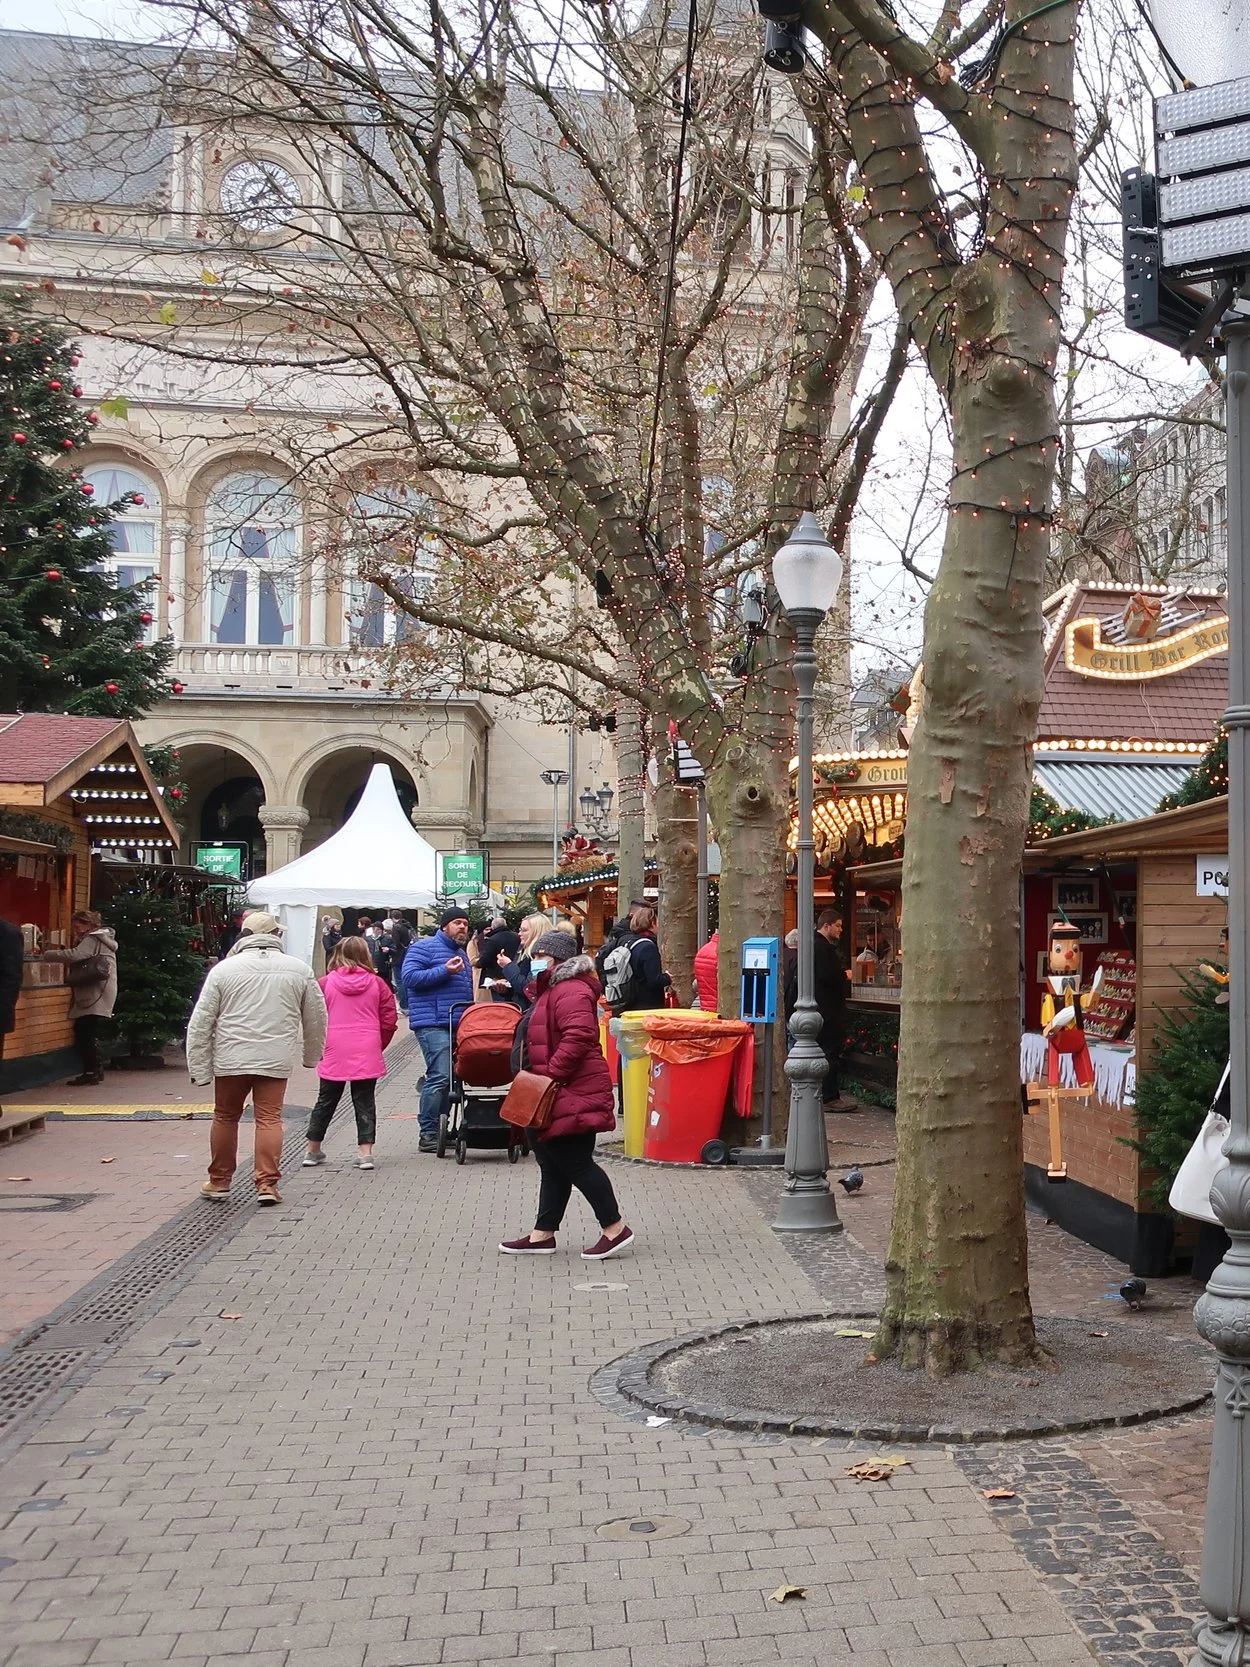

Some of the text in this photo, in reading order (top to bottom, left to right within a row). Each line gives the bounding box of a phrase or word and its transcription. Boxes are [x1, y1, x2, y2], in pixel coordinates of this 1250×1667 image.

[1090, 651, 1141, 671] Grill
[1148, 646, 1186, 670] Bar
[203, 855, 234, 863] SORTIE
[212, 864, 225, 872] DE
[448, 862, 477, 870] SORTIE
[456, 871, 468, 879] DE
